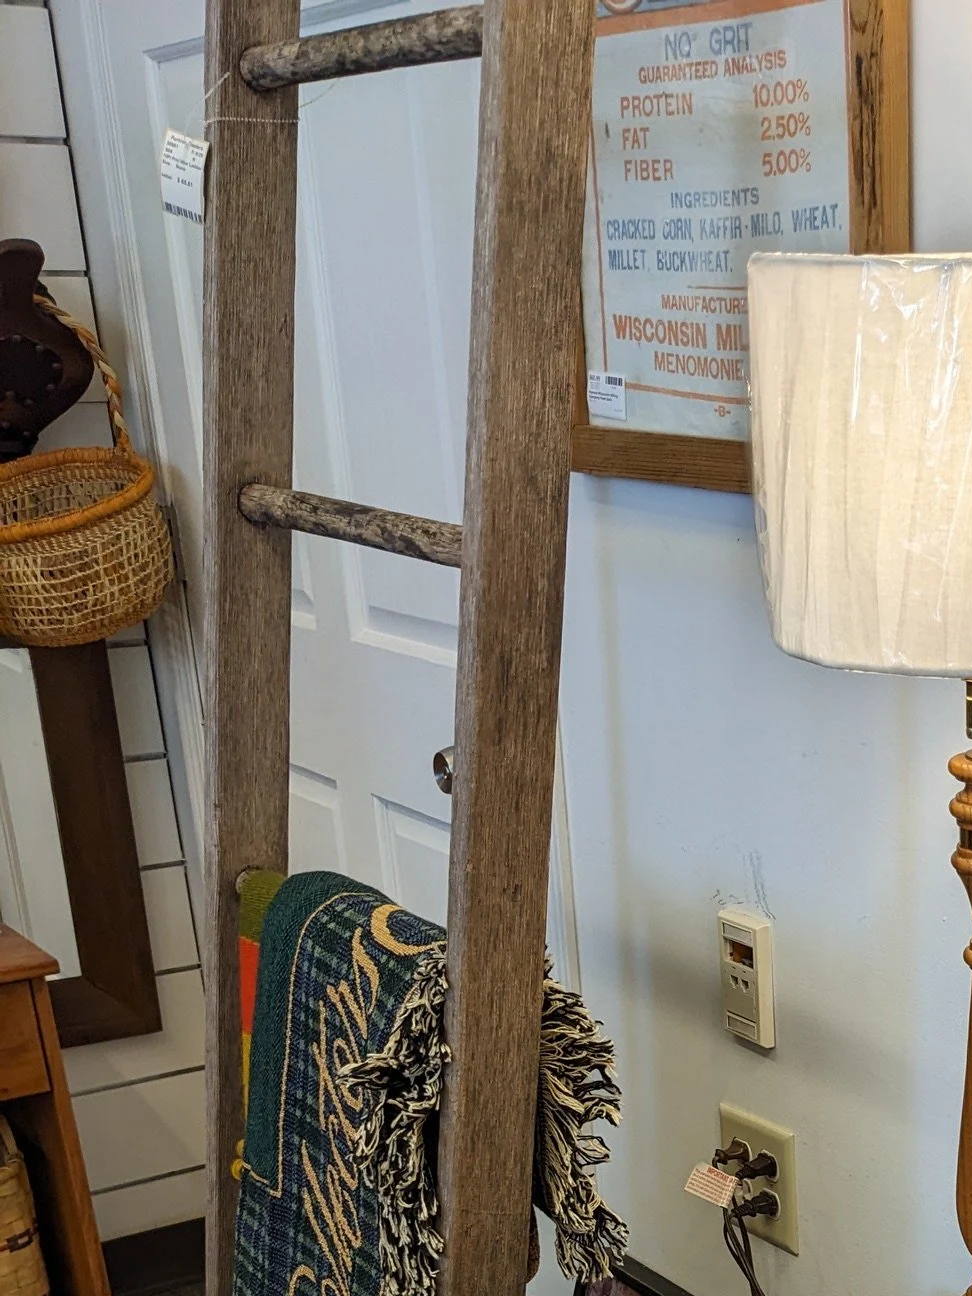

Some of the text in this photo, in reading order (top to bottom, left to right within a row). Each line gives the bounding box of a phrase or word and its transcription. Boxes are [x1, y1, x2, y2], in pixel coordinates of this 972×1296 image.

[664, 22, 753, 61] NO GRIT
[638, 50, 788, 84] GUARANTEED ANALYSIS
[620, 79, 809, 119] PROTEIN 10.00%
[622, 127, 649, 150] FAT
[624, 148, 811, 182] FIBER 5.00%
[670, 187, 760, 209] INGREDIENTS
[606, 218, 656, 241] CRACKED
[662, 218, 694, 243] CORN,
[612, 314, 708, 349] WISCONSIN
